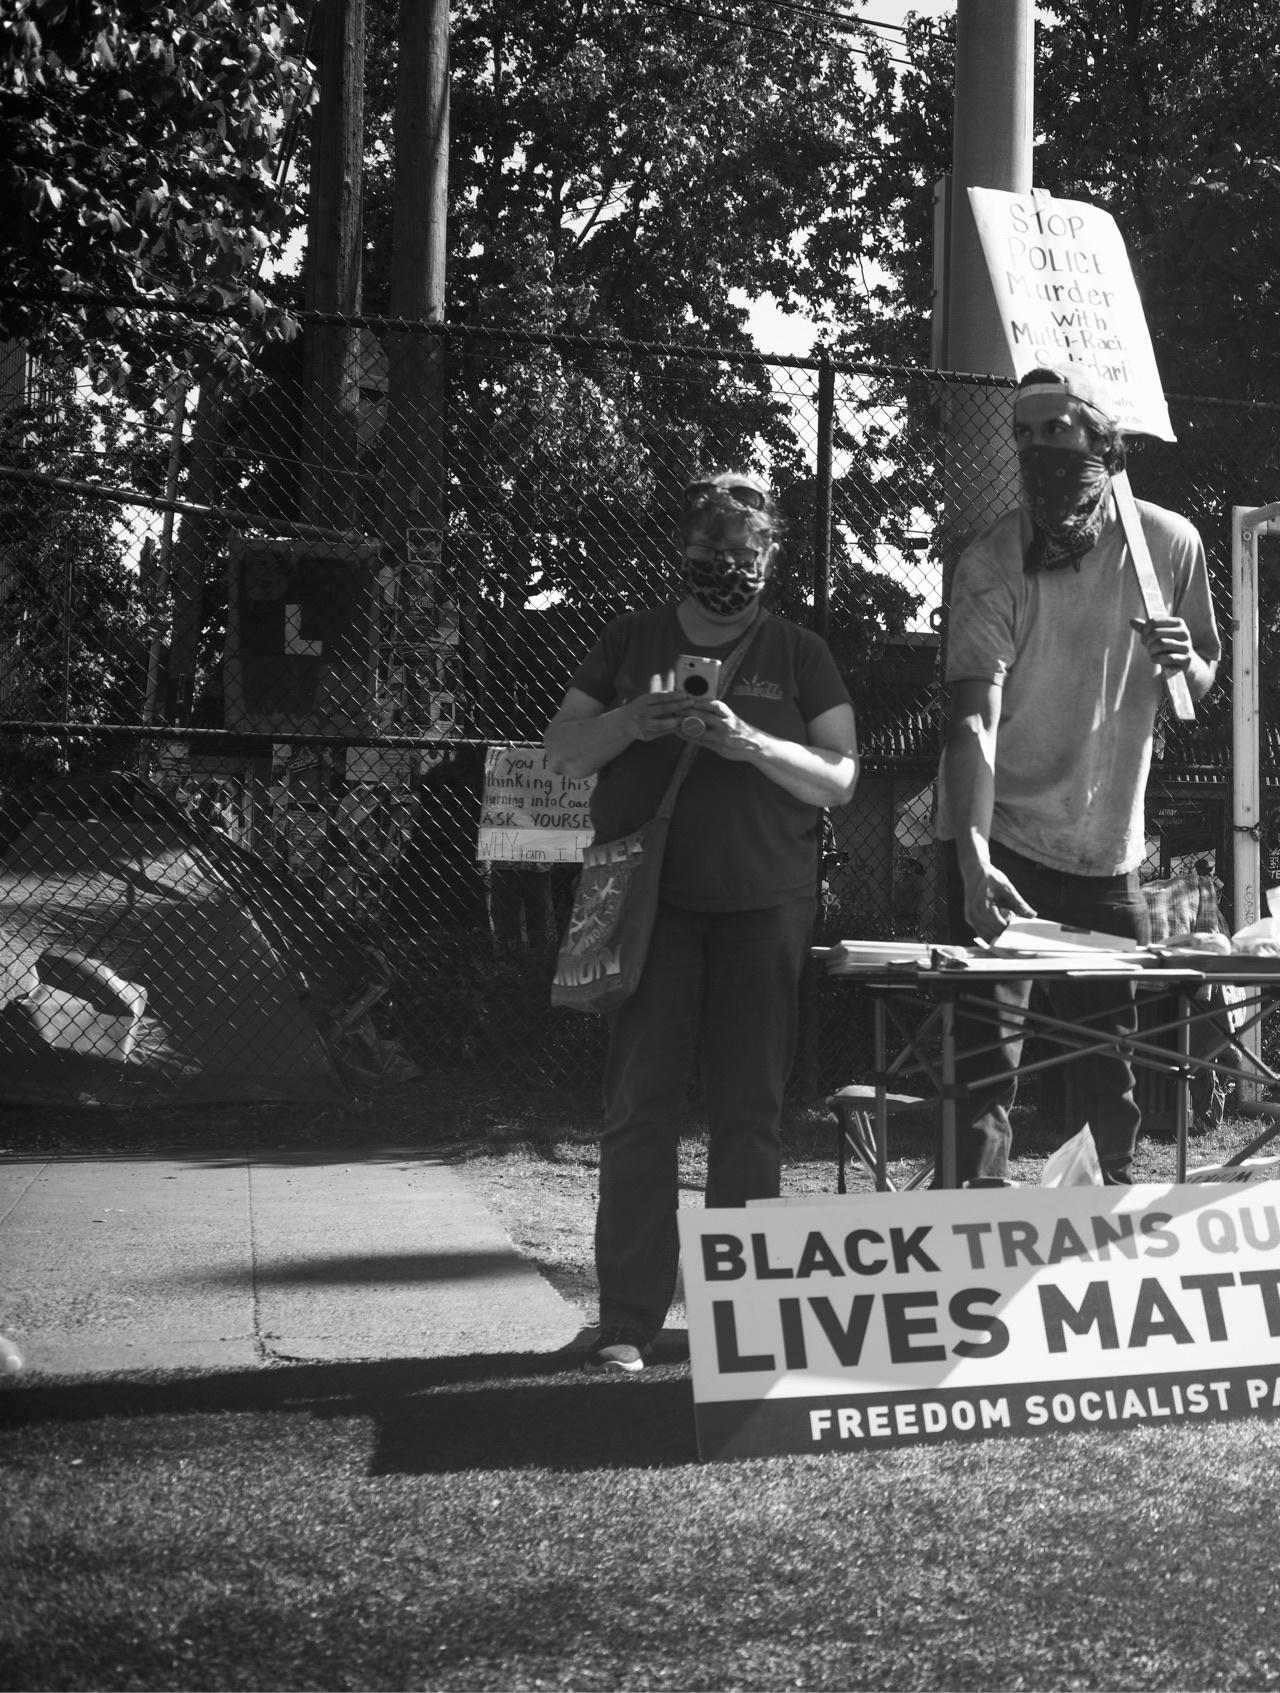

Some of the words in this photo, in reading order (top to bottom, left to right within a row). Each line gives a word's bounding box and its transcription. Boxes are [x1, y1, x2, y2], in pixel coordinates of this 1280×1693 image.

[1009, 204, 1085, 239] STOP
[1006, 271, 1114, 307] Murder
[1051, 308, 1107, 331] with
[505, 758, 534, 776] you
[559, 776, 591, 791] this
[558, 792, 591, 808] Coac
[482, 811, 519, 827] ASK
[480, 831, 519, 860] WHY
[700, 1225, 942, 1282] BLACK
[951, 1211, 1180, 1270] TRANS
[712, 1287, 1010, 1374] LIVES
[809, 1397, 1011, 1441] FREEDOM
[1026, 1382, 1231, 1425] SOCIALIST
